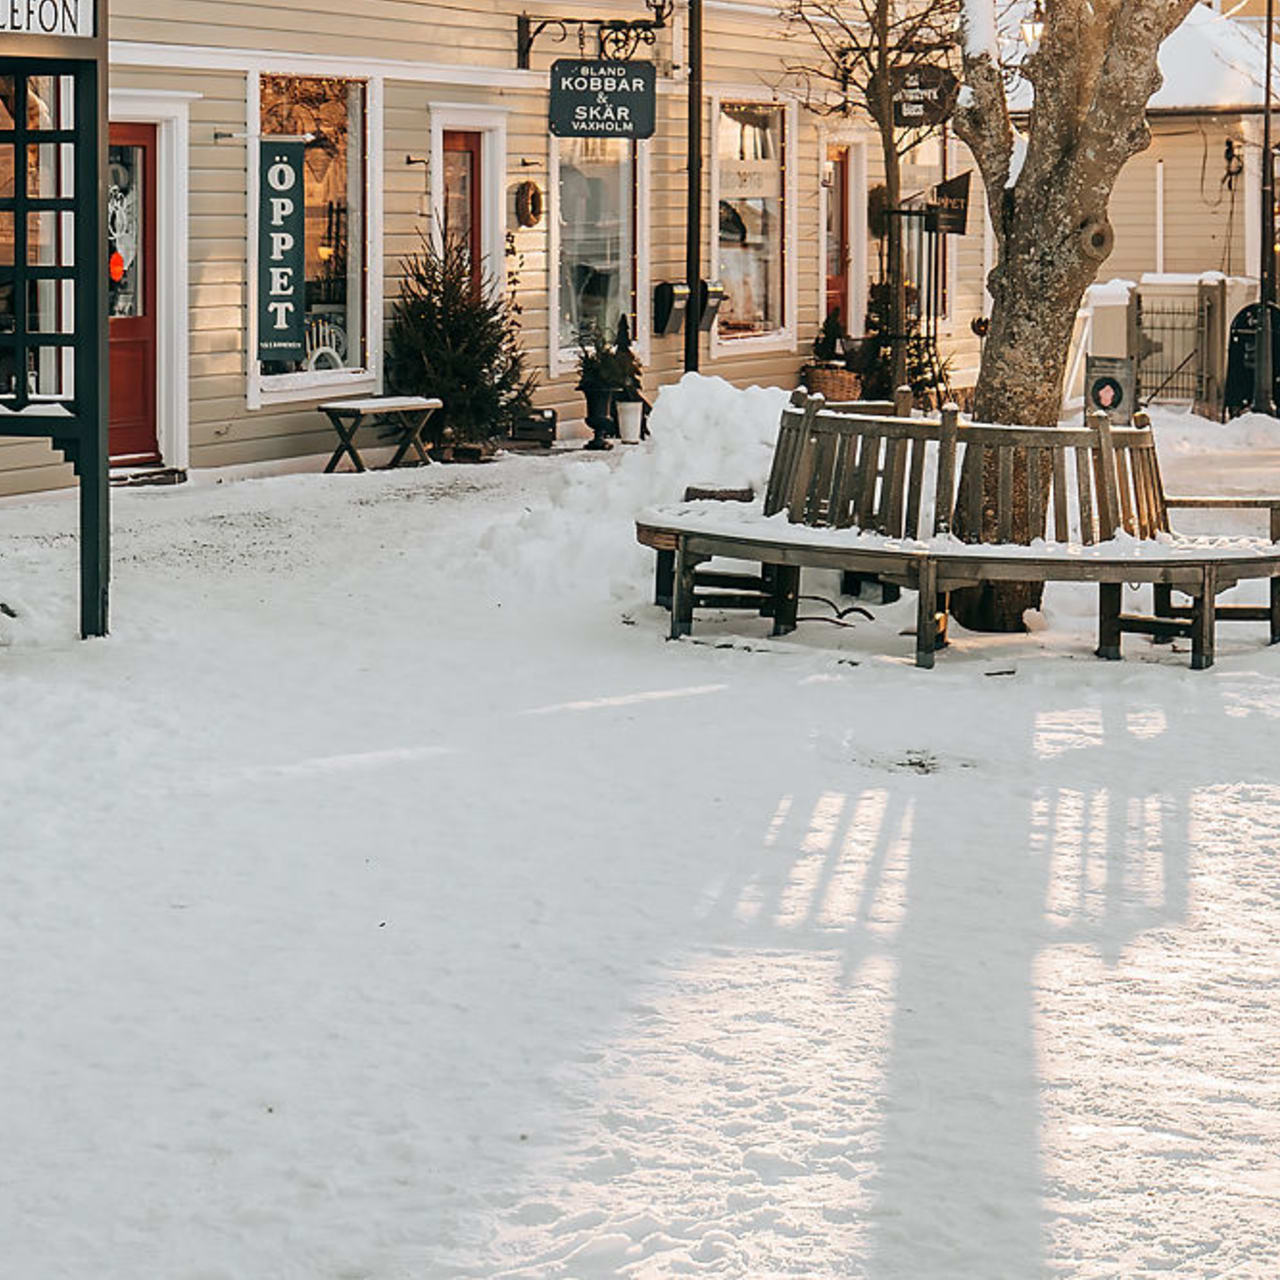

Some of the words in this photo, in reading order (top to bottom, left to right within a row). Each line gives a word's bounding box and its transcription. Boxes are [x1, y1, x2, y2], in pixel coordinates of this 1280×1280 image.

[561, 77, 645, 92] KOBBAR
[596, 91, 608, 104] &
[574, 103, 630, 121] SKÄR
[571, 120, 634, 131] VAXHOLM
[266, 155, 296, 330] ÖPPET
